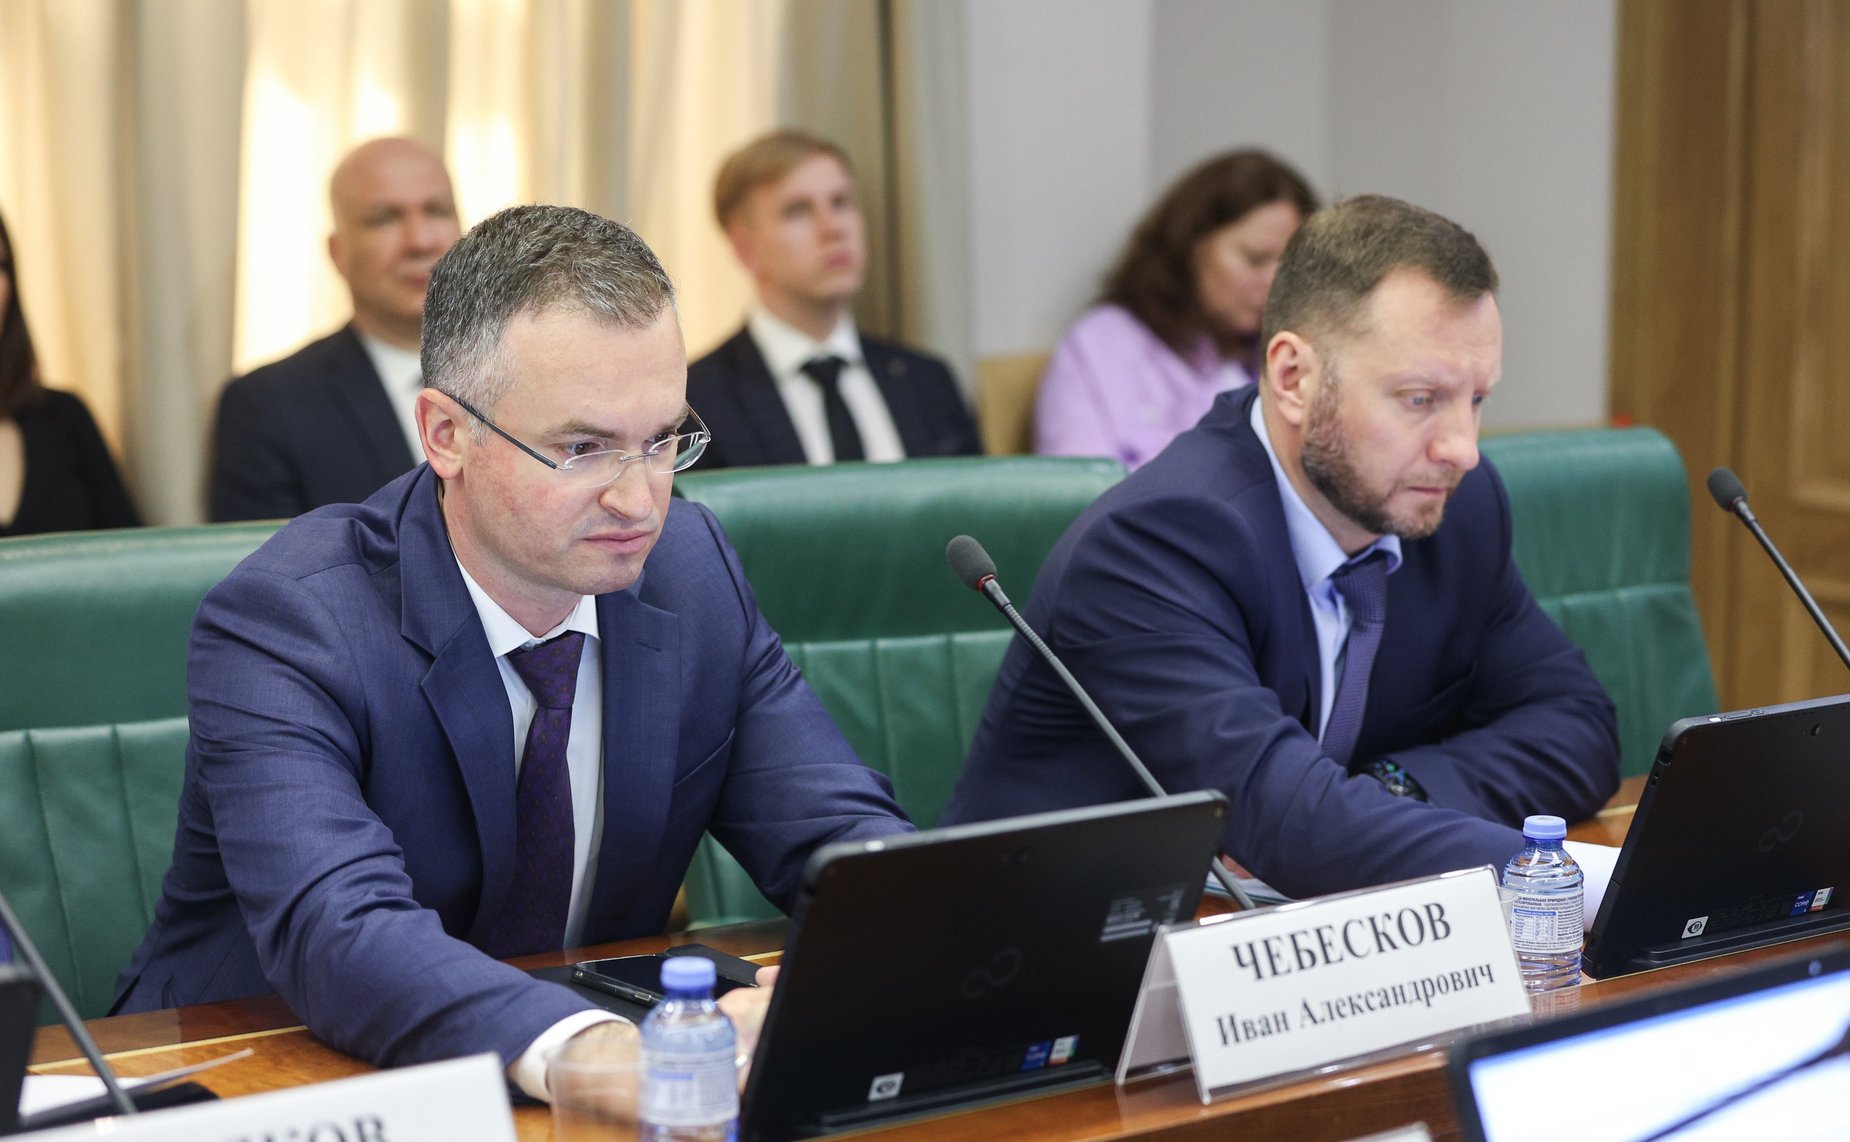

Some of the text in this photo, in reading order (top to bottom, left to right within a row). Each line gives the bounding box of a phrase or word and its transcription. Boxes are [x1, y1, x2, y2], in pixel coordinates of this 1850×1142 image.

[1232, 902, 1451, 980] ЧЕБЕСКОВ
[1217, 963, 1495, 1046] Иван Александрович
